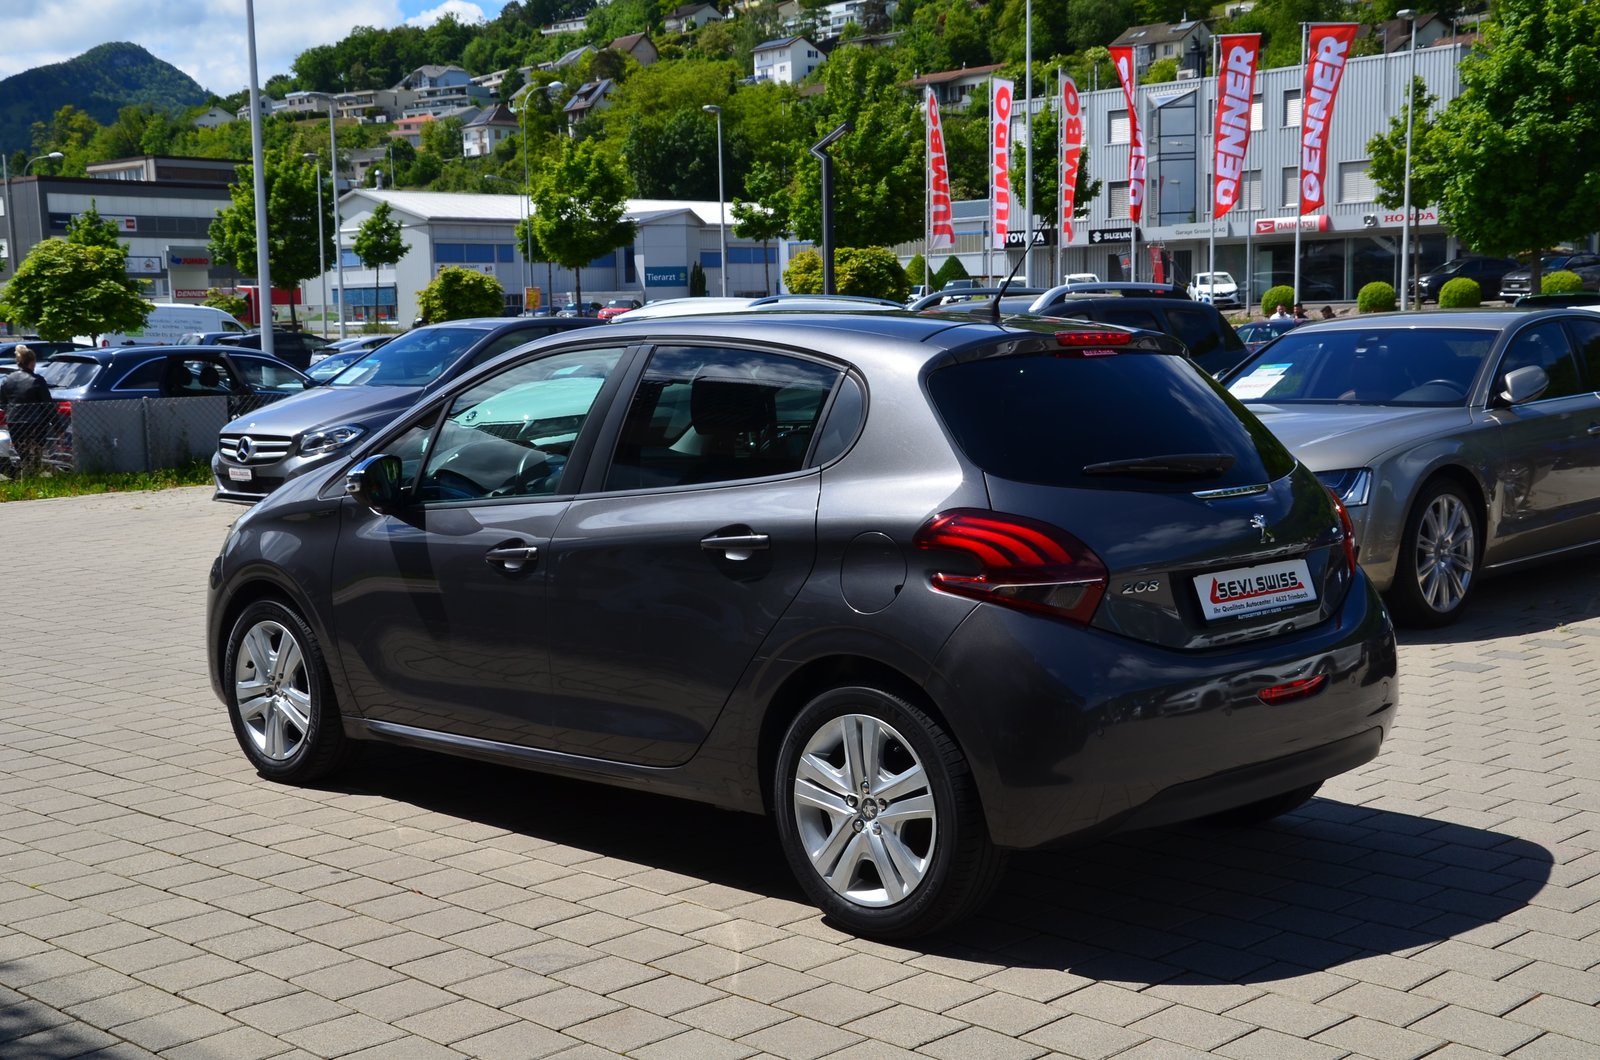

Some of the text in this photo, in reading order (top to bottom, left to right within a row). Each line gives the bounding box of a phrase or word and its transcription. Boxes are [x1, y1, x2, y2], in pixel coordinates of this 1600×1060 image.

[1216, 45, 1255, 205] DENNER
[1302, 36, 1348, 202] DENNER
[929, 94, 955, 244] JUMBO
[995, 86, 1011, 244] JUMBO
[1063, 81, 1083, 243] JUMBO
[1384, 212, 1435, 222] HONDA
[182, 257, 209, 265] JUMBO
[646, 273, 676, 281] Tierarzt
[1122, 580, 1160, 595] 208
[1217, 571, 1298, 599] SEVI.SWISS
[1213, 606, 1221, 614] Ihr
[1245, 599, 1271, 609] Autocenter
[1287, 591, 1309, 601] Trimbach
